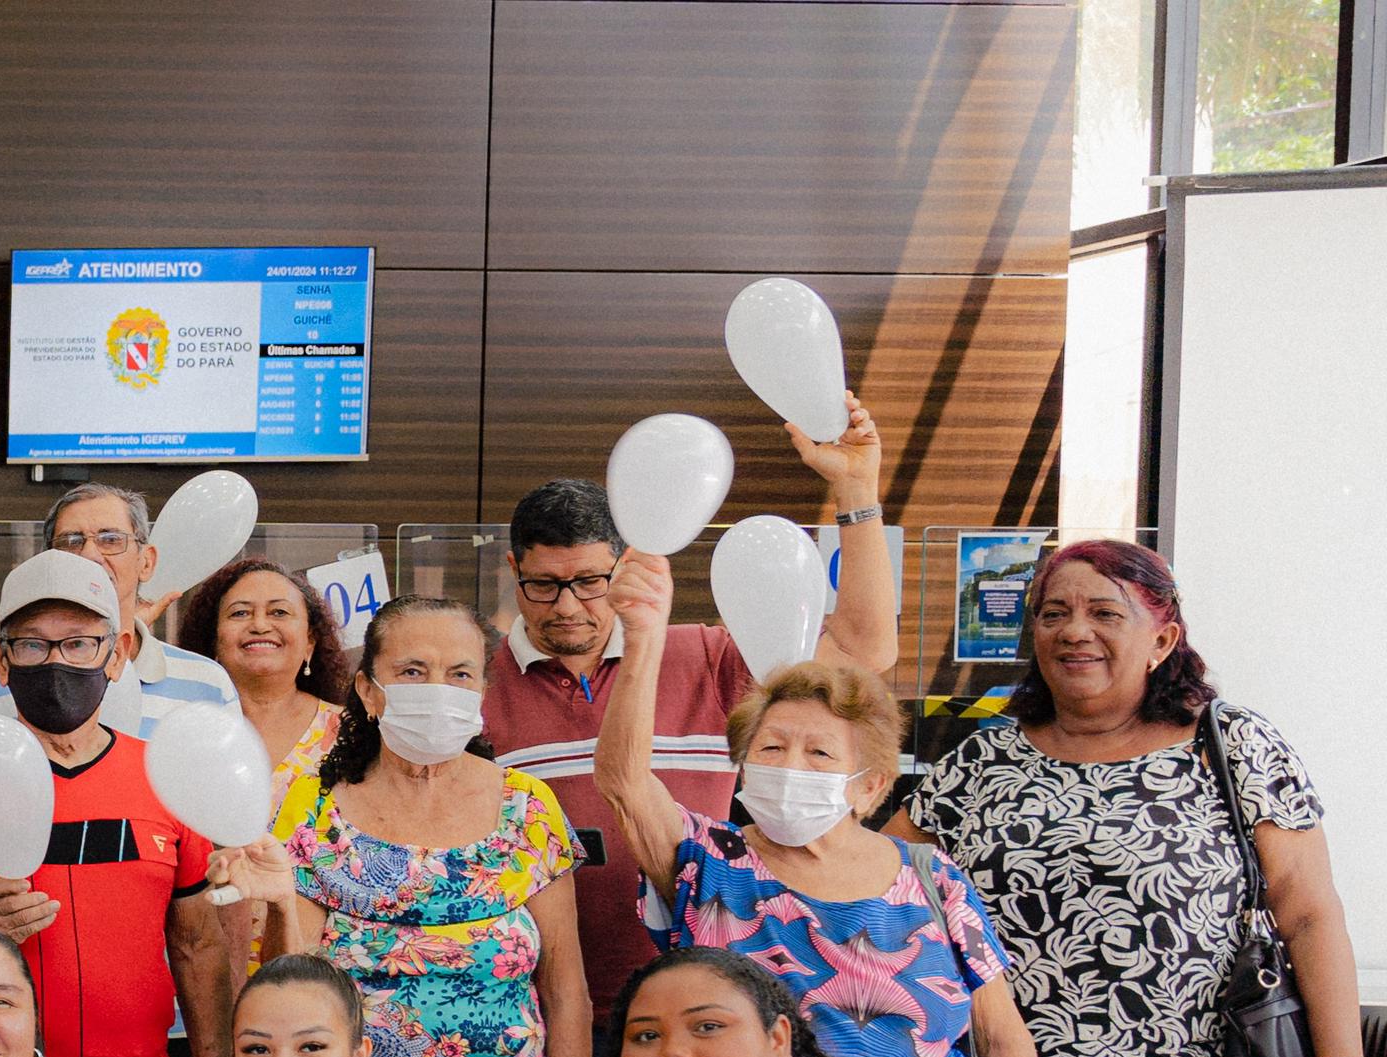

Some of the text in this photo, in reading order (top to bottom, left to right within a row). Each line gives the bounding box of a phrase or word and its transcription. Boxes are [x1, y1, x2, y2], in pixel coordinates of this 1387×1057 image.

[78, 262, 202, 278] ATENDIMENTO
[266, 265, 357, 277] 24/01/2024 11:12:27
[297, 285, 331, 295] SENHA
[293, 314, 332, 325] GUICHÊ
[178, 327, 243, 337] GOVERNO
[177, 342, 253, 353] DO ESTADO
[267, 344, 356, 356] Últimas Chamadas
[176, 356, 235, 368] DO PARÁ
[78, 434, 187, 445] Atendimento IGEPREV
[324, 573, 381, 630] 04
